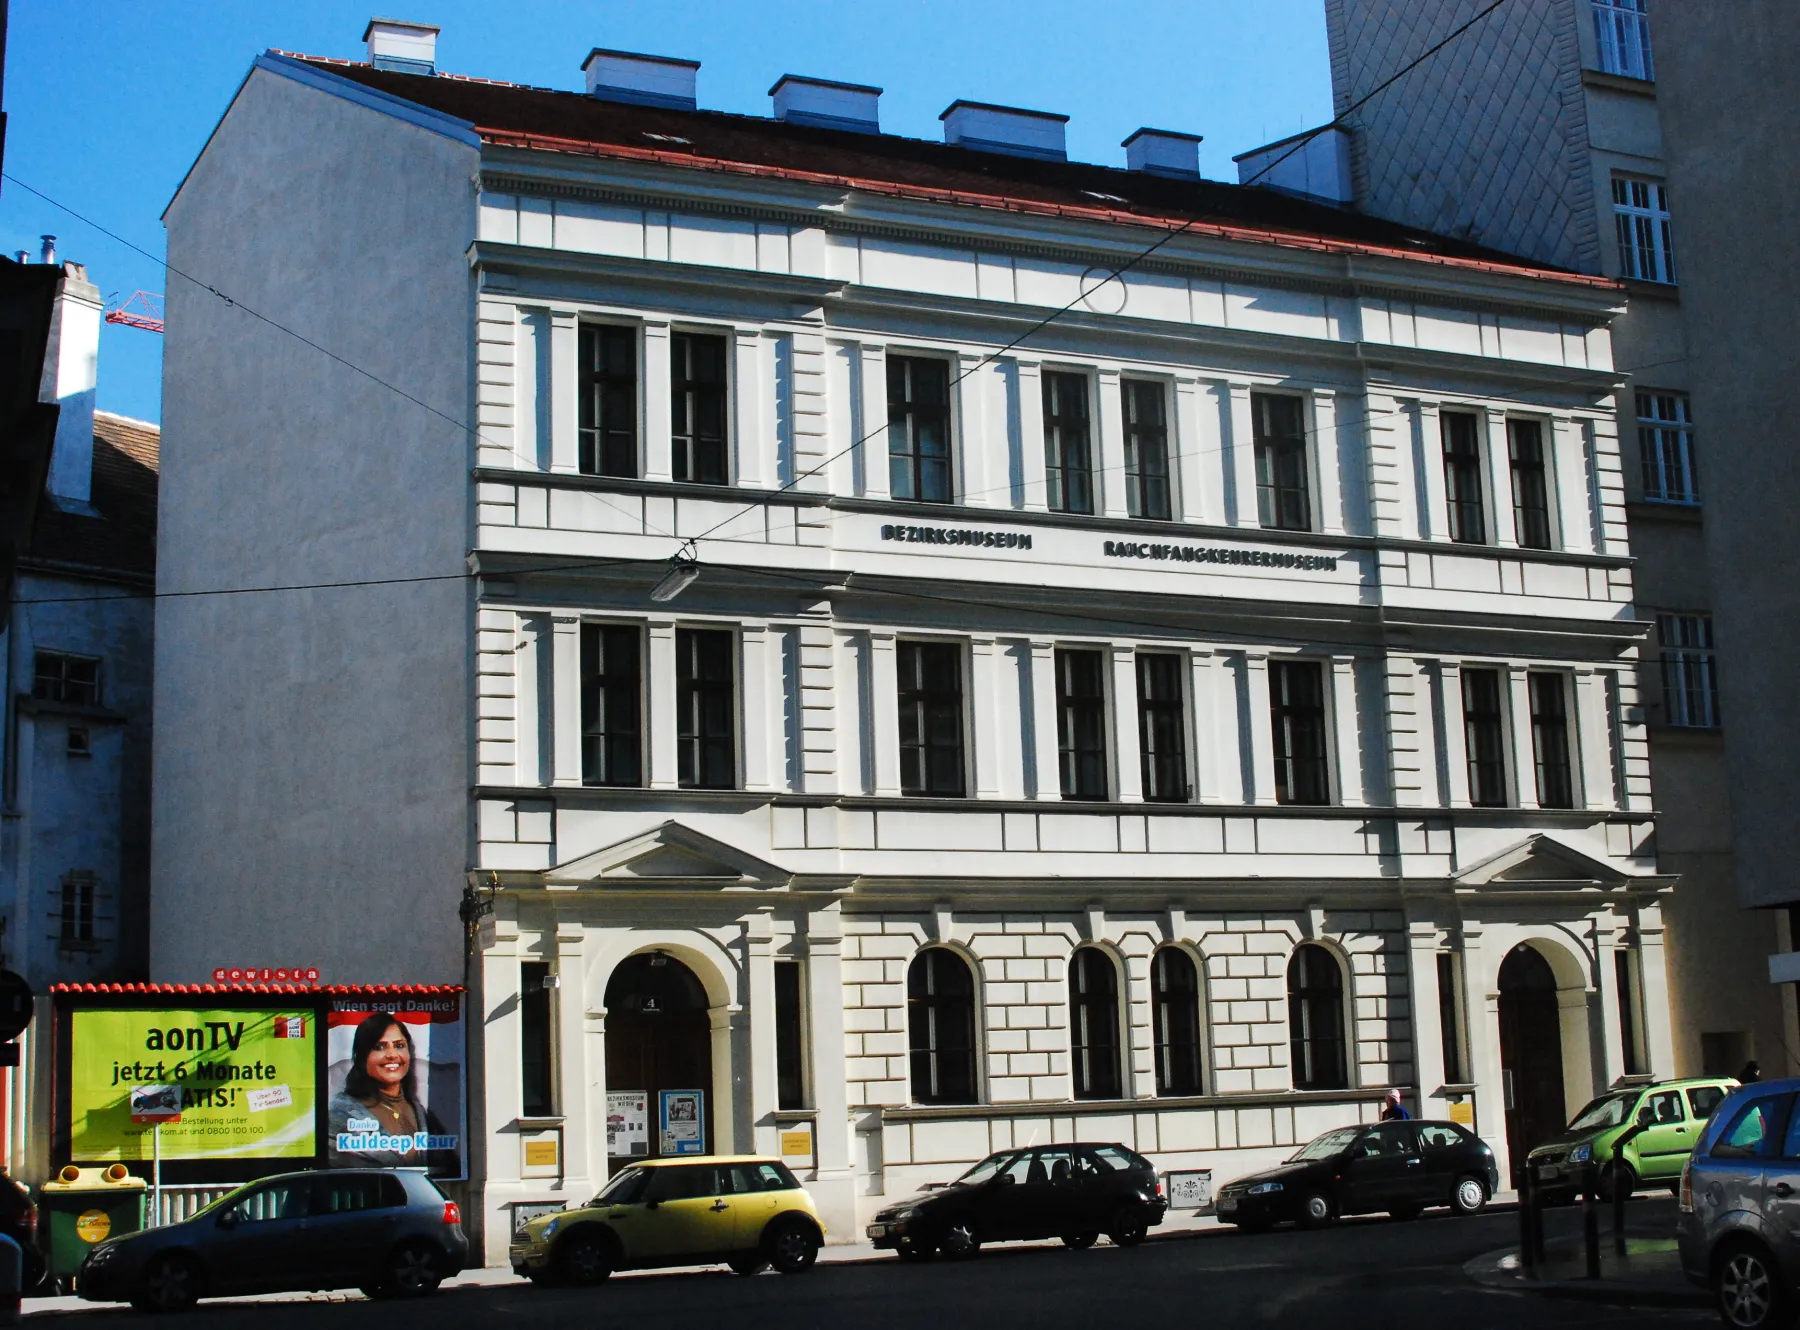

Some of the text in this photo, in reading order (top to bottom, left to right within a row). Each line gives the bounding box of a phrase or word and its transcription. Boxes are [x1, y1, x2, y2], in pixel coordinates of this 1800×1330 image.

[881, 525, 1032, 550] BEZIRKSMUSEUM
[1103, 541, 1337, 571] RAUCHFANGKEHRERMUSEUM
[216, 969, 317, 979] gewista
[333, 1001, 455, 1014] Wien sagt Danke!
[647, 999, 655, 1007] 4
[146, 1022, 244, 1051] aonTV
[112, 1060, 276, 1086] jetzt 6 Monate
[181, 1087, 242, 1107] ATIS!
[272, 1089, 282, 1097] 90
[182, 1117, 223, 1125] Bestellung
[349, 1120, 377, 1129] Danke
[232, 1126, 248, 1134] 100
[339, 1134, 455, 1152] Kuldeep Kaur
